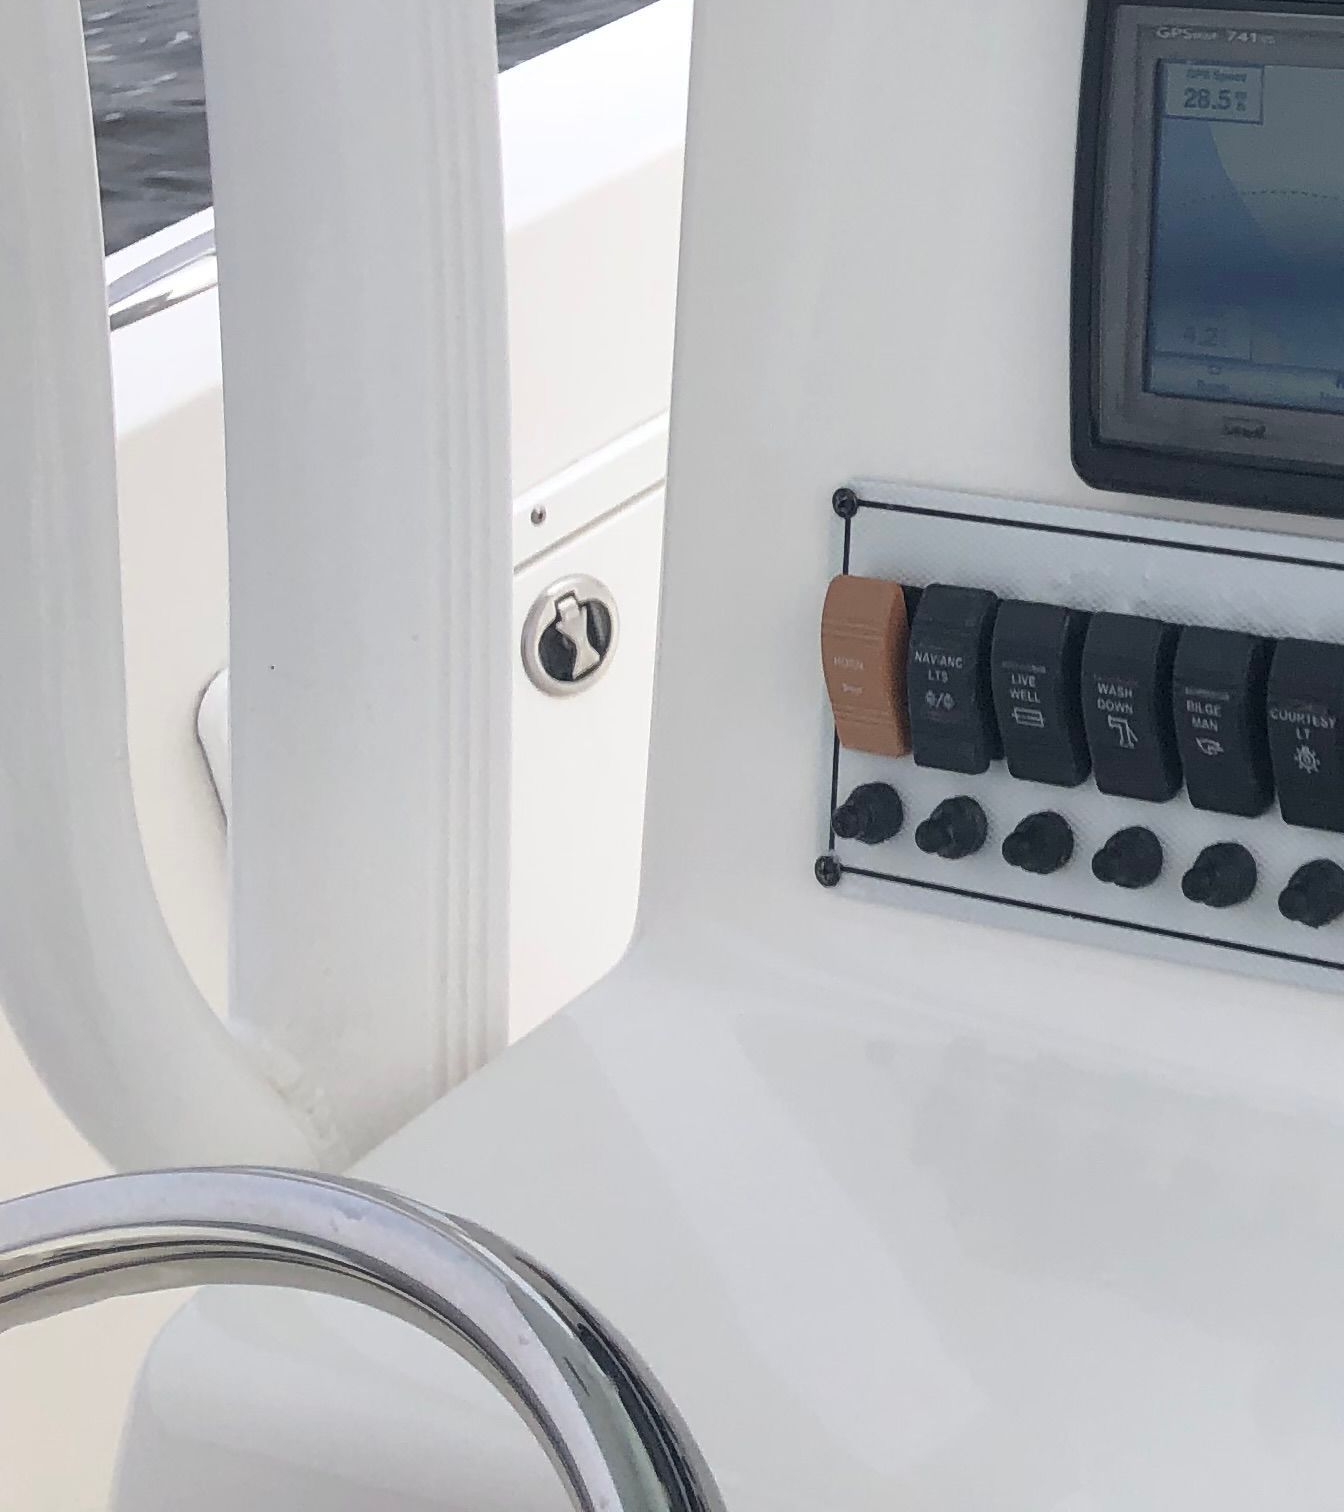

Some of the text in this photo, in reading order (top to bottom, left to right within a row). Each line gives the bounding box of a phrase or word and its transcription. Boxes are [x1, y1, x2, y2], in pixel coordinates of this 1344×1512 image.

[1184, 87, 1231, 110] 28.5
[928, 669, 949, 684] LTS
[1011, 673, 1036, 688] LIVE
[1010, 688, 1041, 704] WELL
[1097, 682, 1133, 699] WASH
[1097, 696, 1134, 715] DOWN
[1186, 699, 1222, 718] BILGE
[1192, 716, 1218, 733] MAN
[1271, 708, 1336, 729] COURTESY
[1295, 727, 1311, 740] LT
